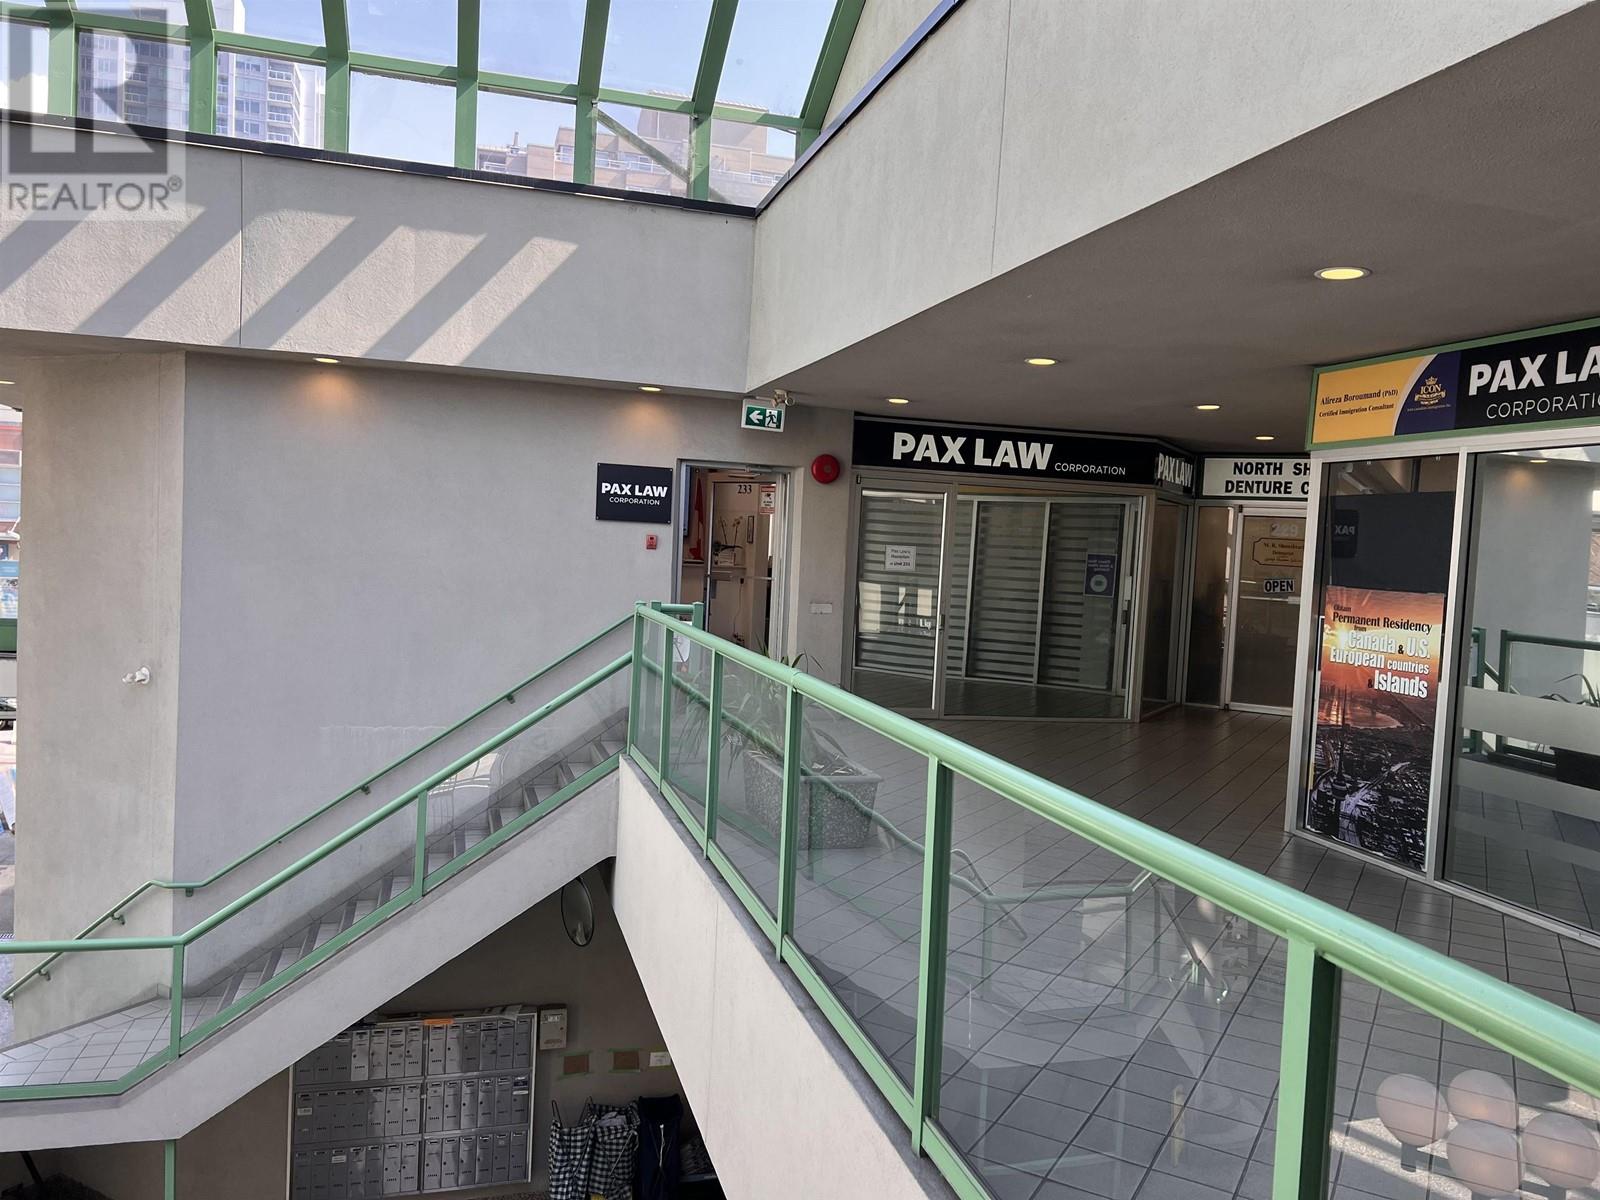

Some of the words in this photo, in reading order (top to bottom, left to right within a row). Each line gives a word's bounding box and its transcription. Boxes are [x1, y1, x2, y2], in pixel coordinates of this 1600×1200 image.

[1468, 353, 1547, 396] PAX
[1321, 396, 1342, 405] Alireza
[1382, 389, 1399, 398] (PhD)
[1420, 383, 1442, 395] ICON
[1339, 406, 1367, 415] Immigration
[1368, 403, 1394, 411] Consultant
[892, 431, 967, 465] PAX
[974, 438, 1054, 470] LAW
[1054, 462, 1126, 476] CORPORATION
[1157, 452, 1176, 483] PAX
[1175, 459, 1193, 488] LAW
[1233, 461, 1283, 476] NORTH
[601, 482, 632, 496] PAX
[634, 484, 668, 498] LAW
[737, 484, 752, 494] 233
[1224, 480, 1293, 495] DENTURE
[609, 496, 660, 506] CORPORATION
[1270, 523, 1298, 537] 229
[1264, 580, 1294, 593] OPEN
[1333, 611, 1380, 627] Permanent
[1383, 616, 1432, 636] Residency
[1348, 630, 1396, 653] Canada
[1397, 644, 1404, 655] &
[1406, 636, 1431, 659] U.S.
[1329, 646, 1385, 669] European
[1387, 659, 1430, 674] countries
[1368, 678, 1374, 688] &
[1374, 670, 1428, 699] Islands
